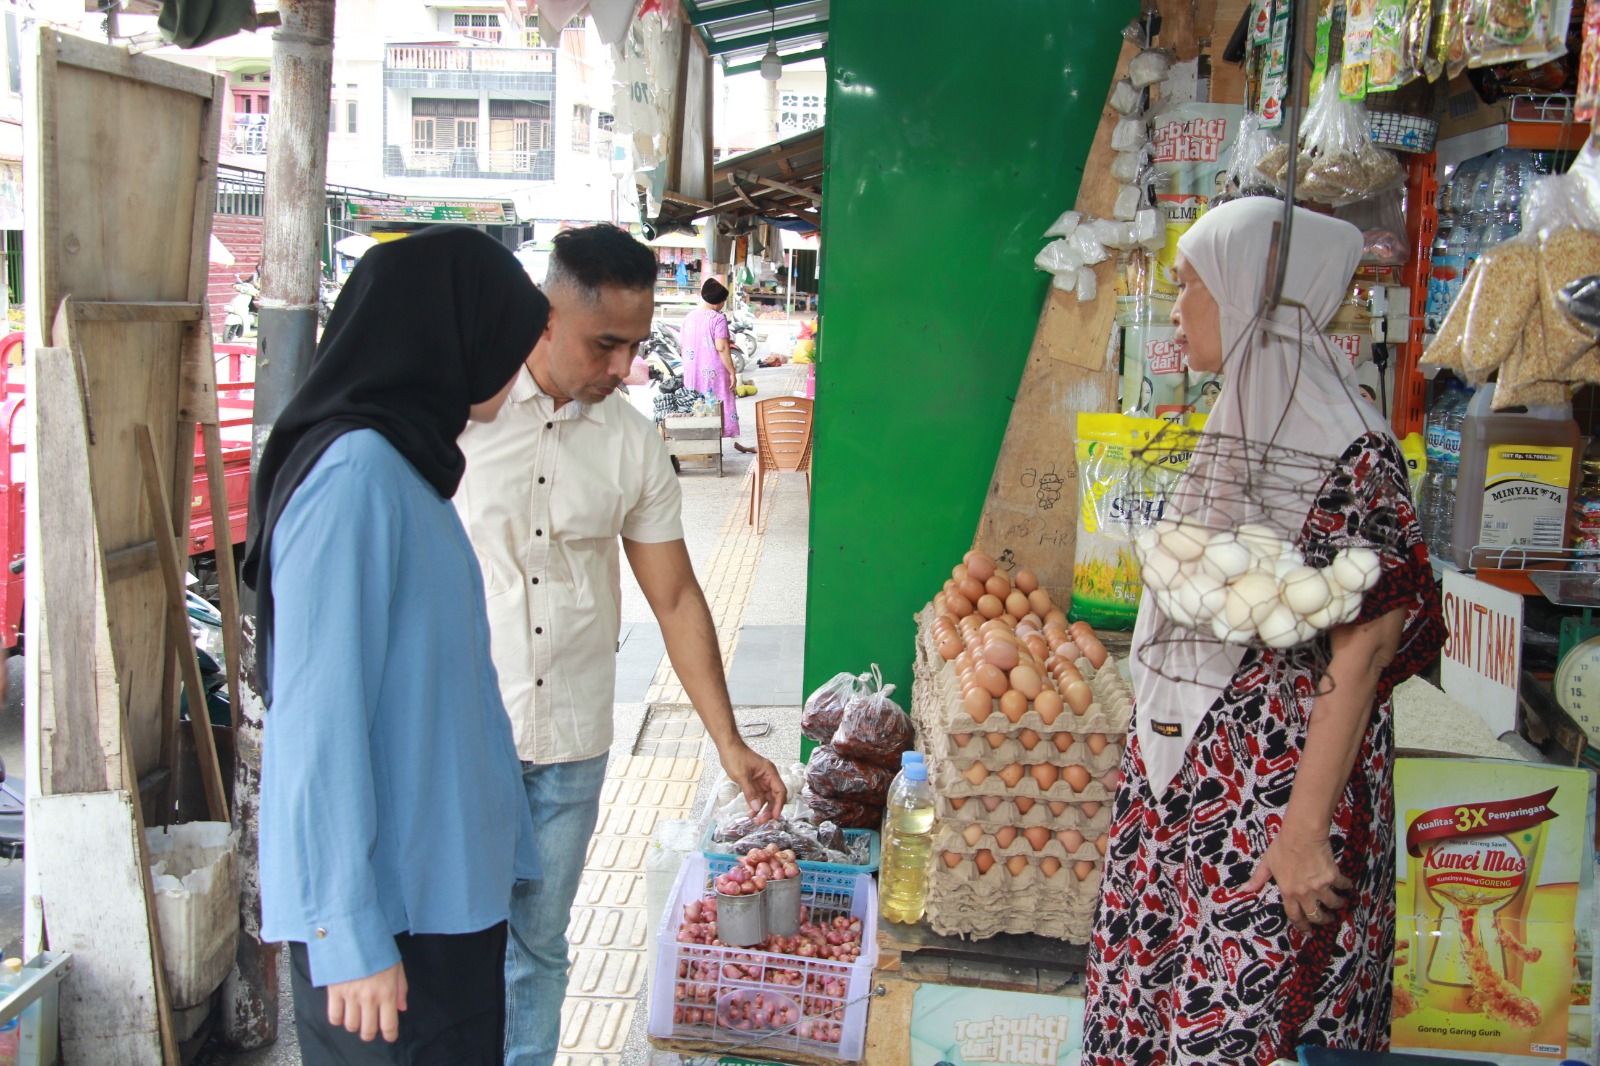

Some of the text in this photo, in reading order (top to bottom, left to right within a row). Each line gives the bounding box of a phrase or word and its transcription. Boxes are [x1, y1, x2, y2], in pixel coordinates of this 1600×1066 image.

[1174, 136, 1219, 162] Hati
[1150, 354, 1179, 373] dari
[1109, 497, 1166, 521] SPH
[1114, 585, 1123, 599] 5
[1443, 592, 1516, 691] SANTANA
[1571, 687, 1582, 697] 15
[1416, 805, 1546, 832] Kualitas 3X Penyaringan
[1423, 847, 1527, 872] Kunci Mas
[1436, 875, 1463, 883] Kuncinya
[954, 1013, 1070, 1043] Terbukti
[1418, 1025, 1501, 1037] Goreng Garing Gurih
[960, 1035, 1059, 1066] dari Hati
